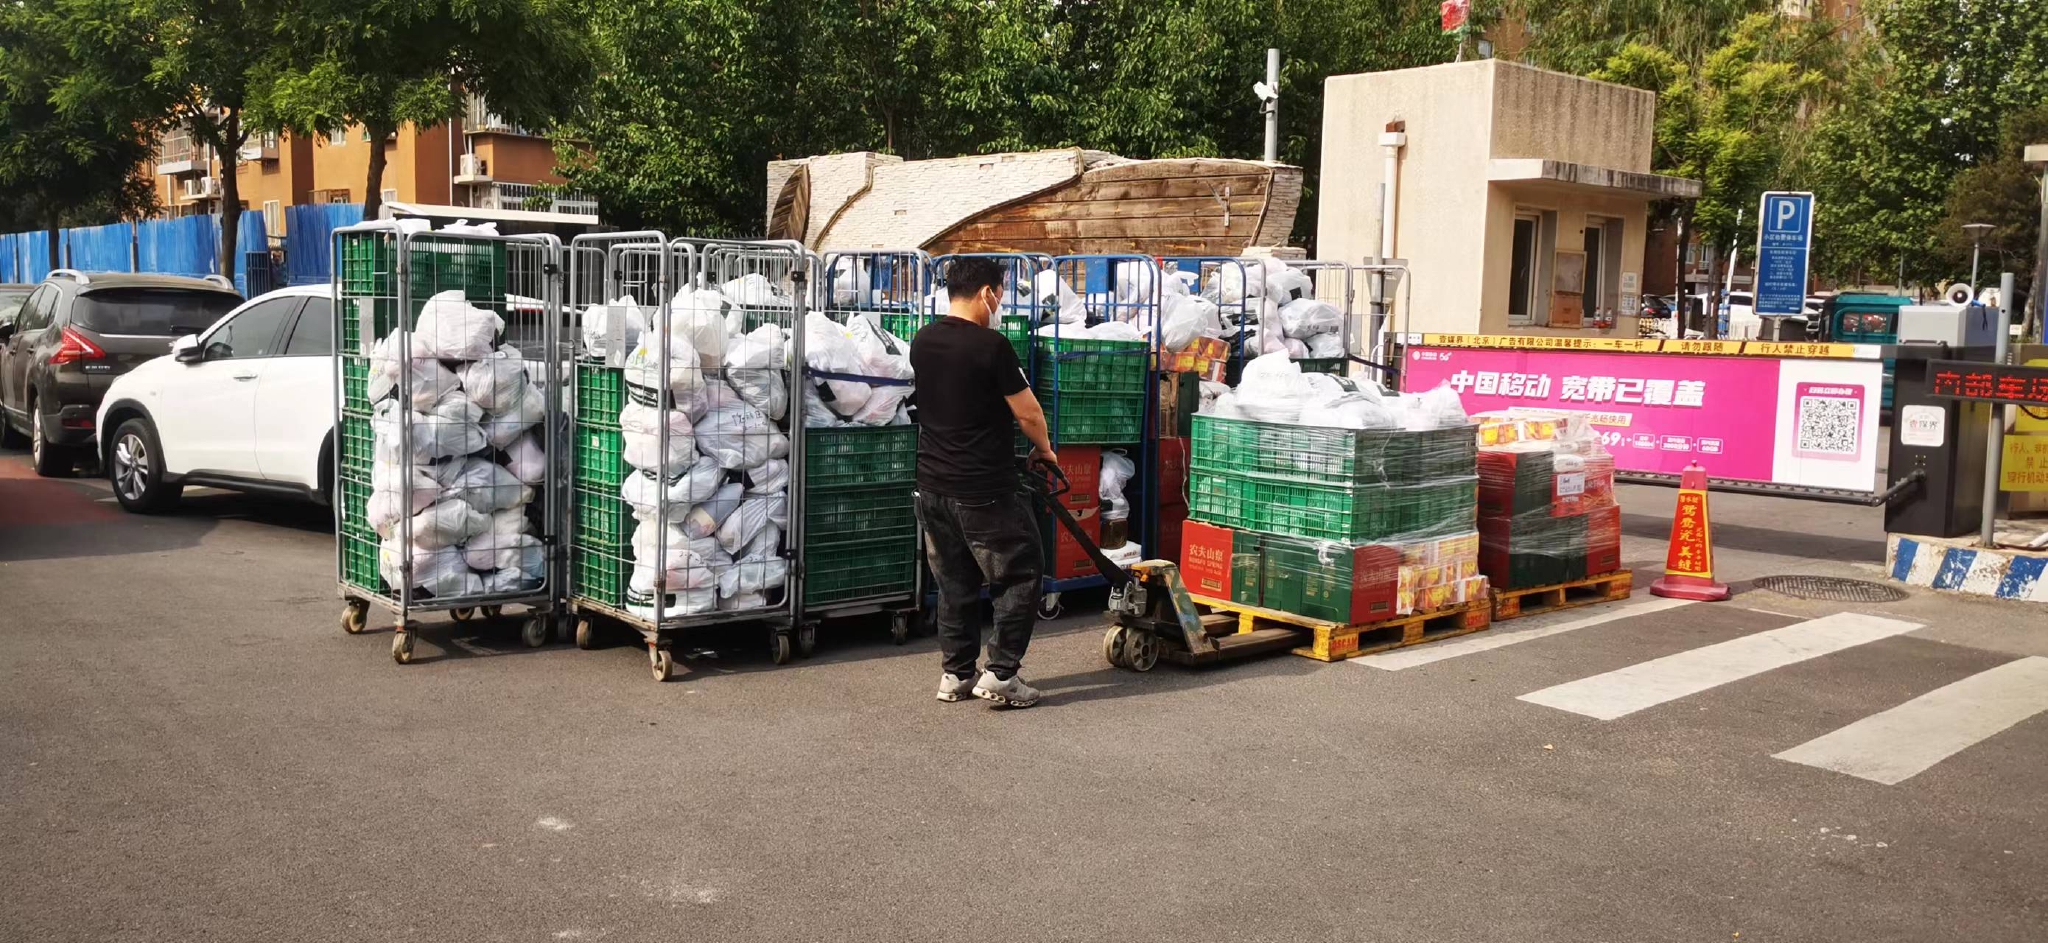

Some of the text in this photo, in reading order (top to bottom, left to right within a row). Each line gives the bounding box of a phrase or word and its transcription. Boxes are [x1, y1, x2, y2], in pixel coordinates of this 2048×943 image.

[1777, 200, 1795, 230] P
[1604, 339, 1643, 349] 一车一杆
[1760, 343, 1830, 355] 行人禁止穿越
[1451, 370, 1706, 407] 中国移动 宽带已覆盖
[2007, 471, 2048, 484] 穿行机动
[1189, 543, 1223, 562] 农夫山泉
